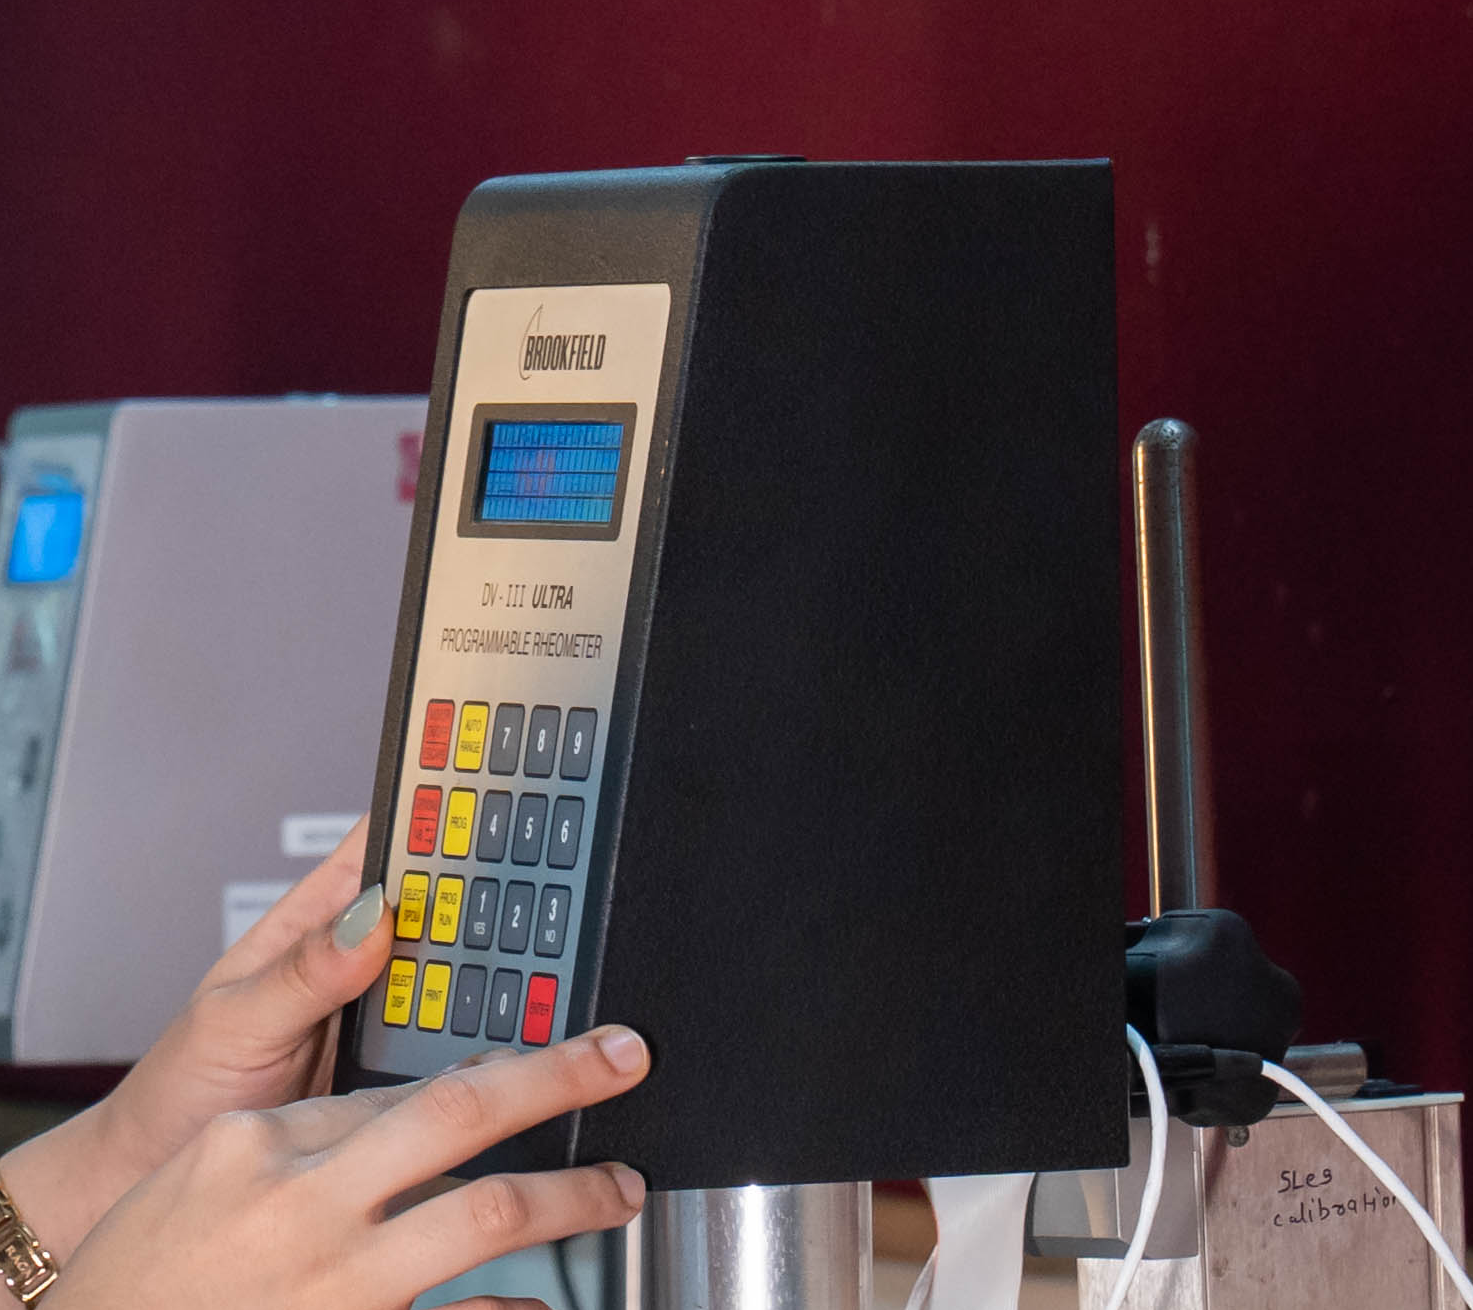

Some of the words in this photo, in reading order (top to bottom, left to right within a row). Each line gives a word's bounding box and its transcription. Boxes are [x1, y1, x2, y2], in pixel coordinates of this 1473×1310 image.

[524, 334, 606, 371] BROOKFIELD
[531, 583, 574, 610] ULTRA
[440, 627, 531, 656] PROGRAMMABLE
[532, 631, 603, 659] RHEOMETER
[502, 727, 511, 750] 7
[537, 728, 546, 753] 8
[573, 731, 582, 755] 9
[489, 814, 498, 837] 4
[525, 817, 534, 840] 5
[560, 819, 570, 843] 6
[479, 890, 487, 913] 1
[548, 897, 558, 922] 3
[474, 921, 486, 935] YES
[511, 904, 521, 928] 2
[545, 929, 556, 943] NO
[499, 993, 508, 1016] 0
